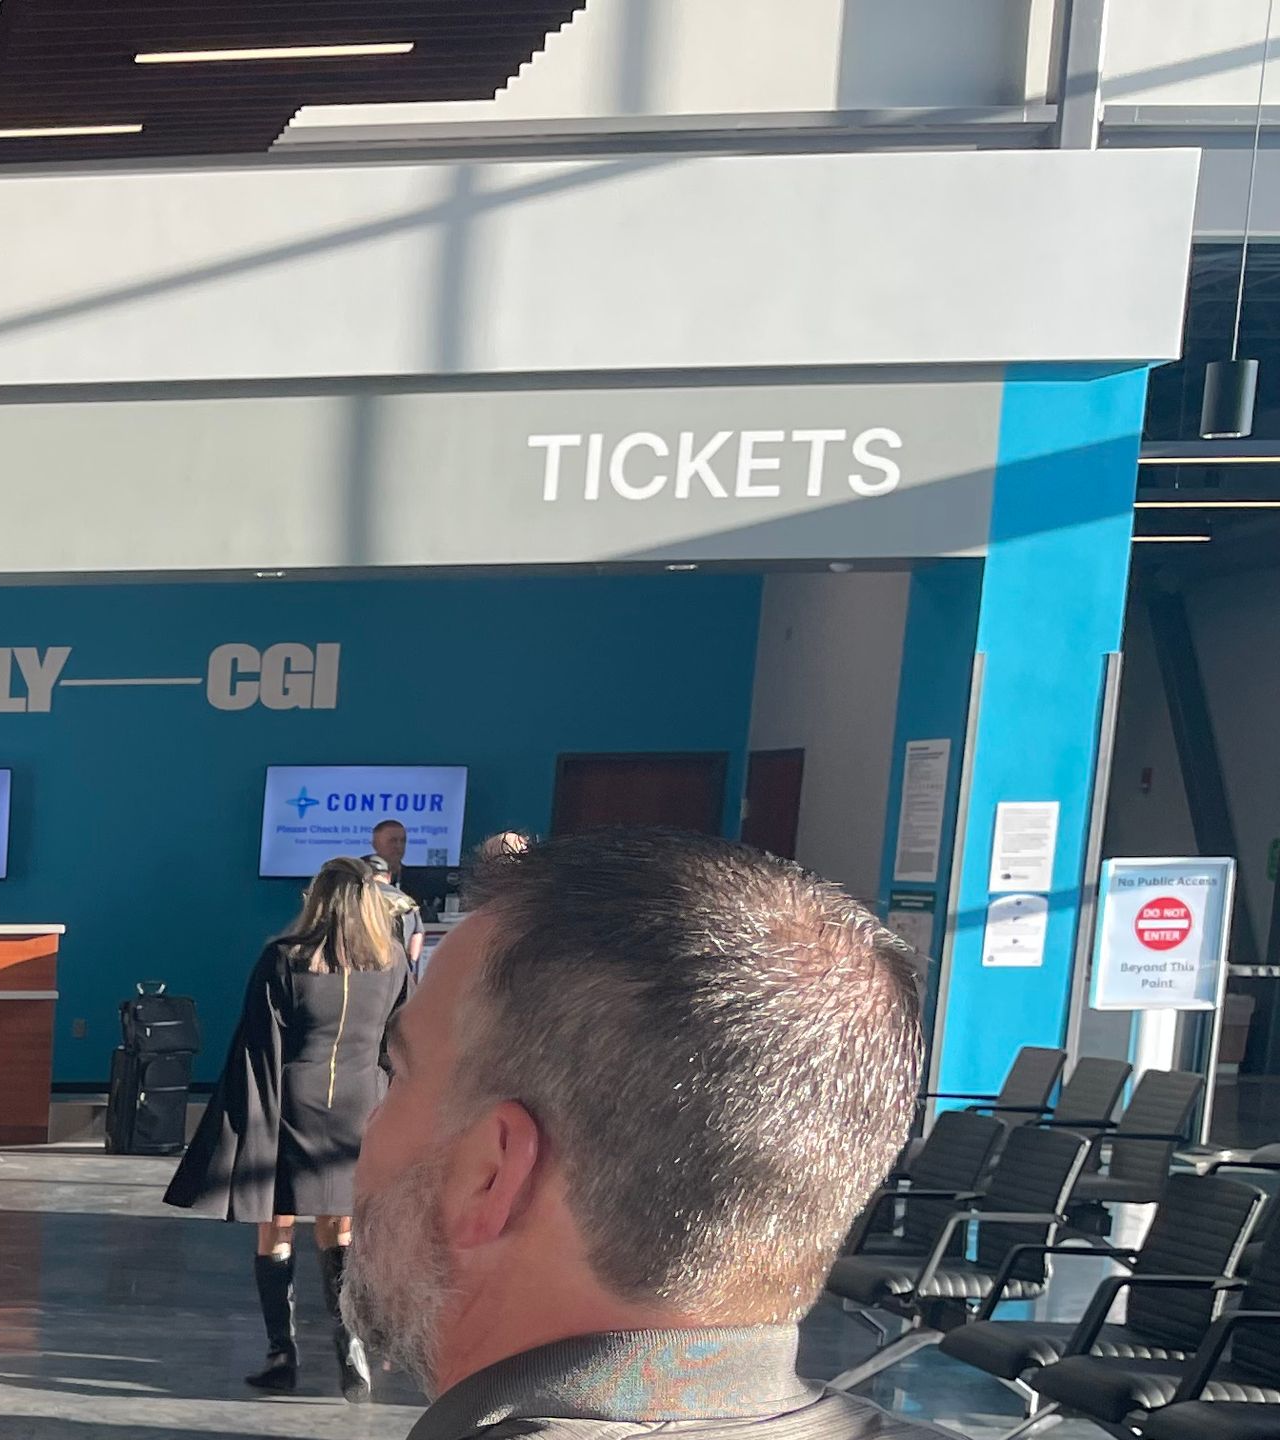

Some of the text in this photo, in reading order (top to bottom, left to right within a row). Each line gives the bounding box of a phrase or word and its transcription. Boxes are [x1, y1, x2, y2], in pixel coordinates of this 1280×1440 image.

[528, 427, 903, 502] TICKETS
[206, 643, 341, 711] CGI
[326, 793, 444, 812] CONTOUR
[1118, 876, 1218, 887] No Public Access
[1143, 907, 1186, 918] DO NOT
[1143, 930, 1181, 942] ENTER
[1120, 962, 1195, 975] Beyond This
[1141, 978, 1174, 988] Point
